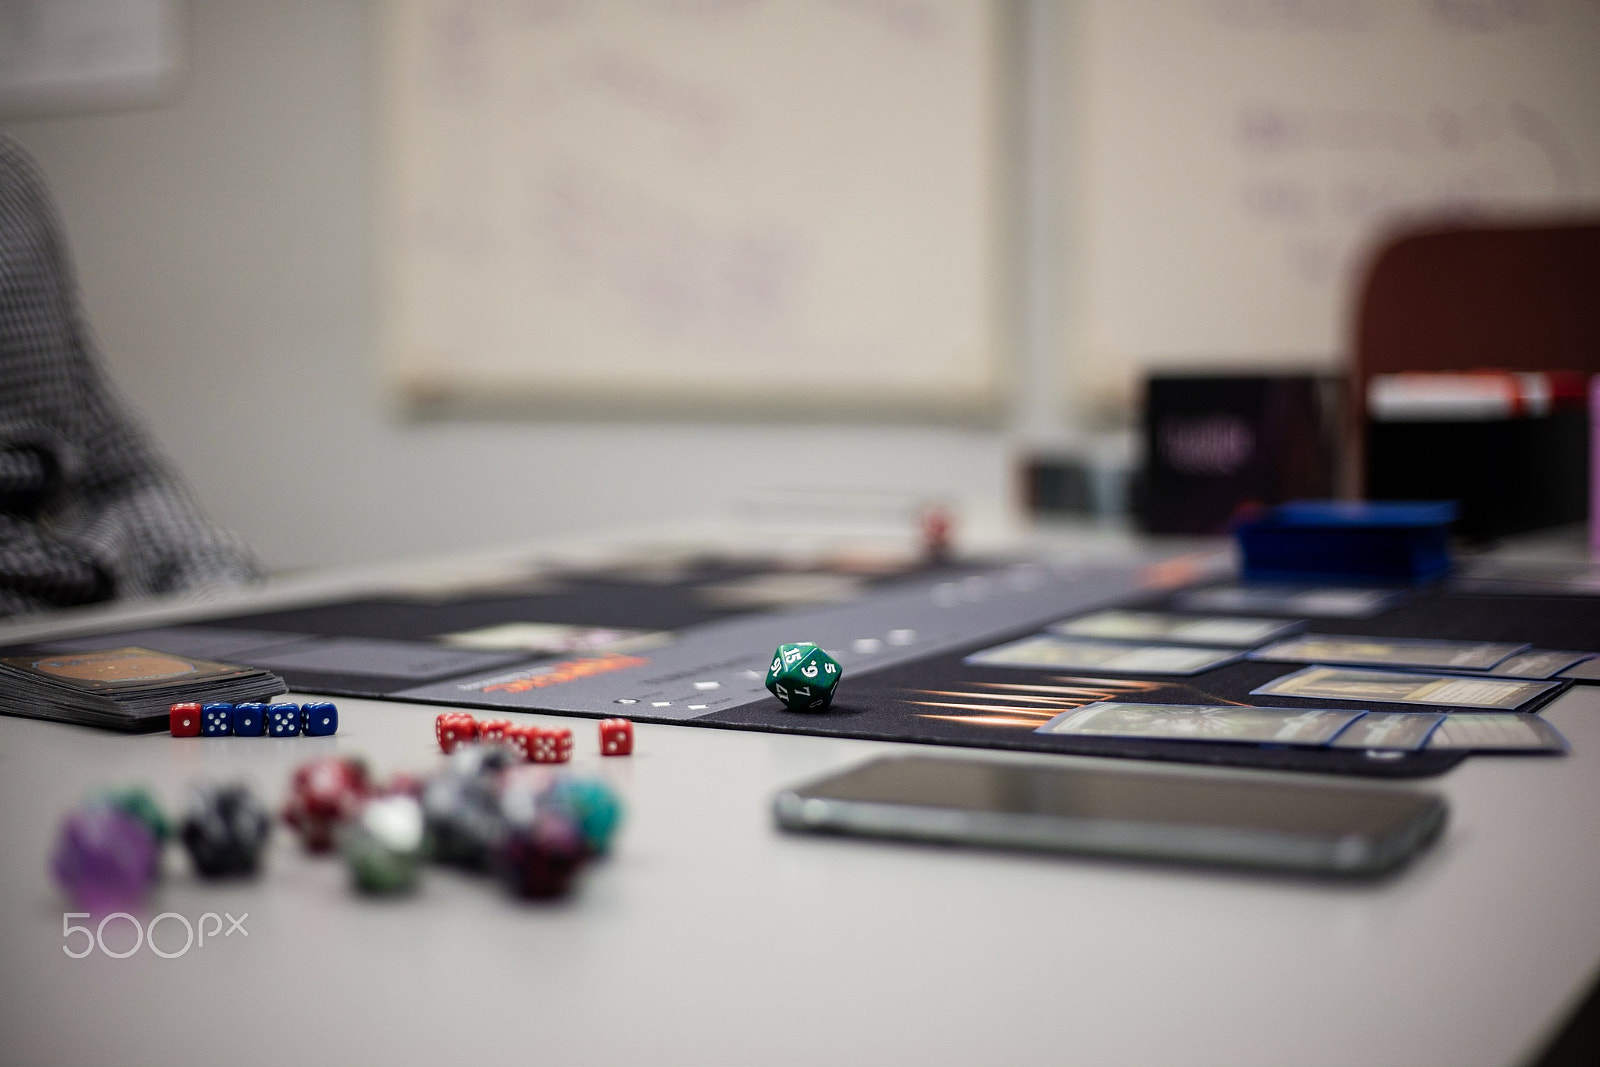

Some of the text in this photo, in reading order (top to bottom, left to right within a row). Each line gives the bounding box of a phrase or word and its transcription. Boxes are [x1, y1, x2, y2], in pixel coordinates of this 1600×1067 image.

[784, 648, 802, 664] 15
[825, 663, 836, 674] 5
[794, 686, 811, 697] 7
